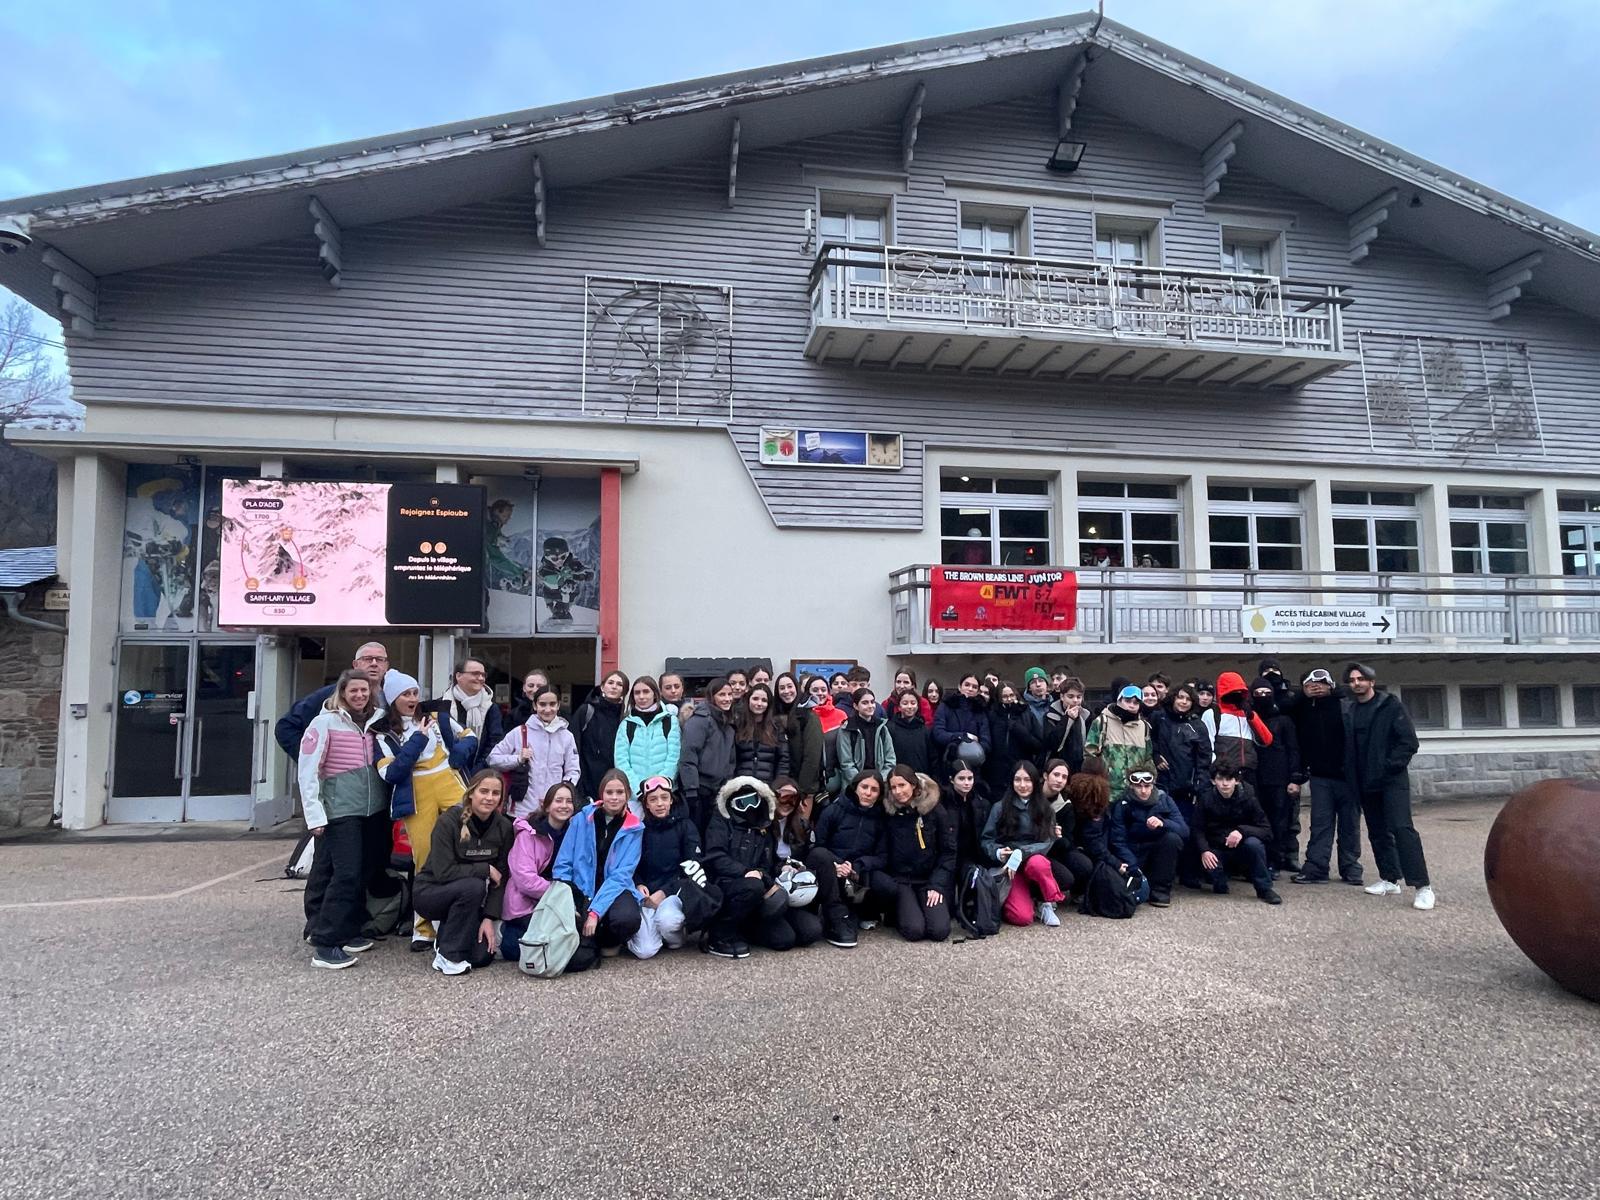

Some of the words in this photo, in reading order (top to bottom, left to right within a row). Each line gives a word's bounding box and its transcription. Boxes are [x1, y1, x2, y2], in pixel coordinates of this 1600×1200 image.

[944, 571, 958, 580] THE
[960, 572, 984, 581] BROWN
[985, 573, 1007, 582] BEARS
[1008, 574, 1024, 582] LINE
[1028, 572, 1062, 584] JUNIOR
[995, 585, 1029, 599] FWT
[1035, 589, 1052, 600] 6-7
[1275, 609, 1297, 617] ACCÈS
[1299, 609, 1338, 617] TÉLÉCABINE
